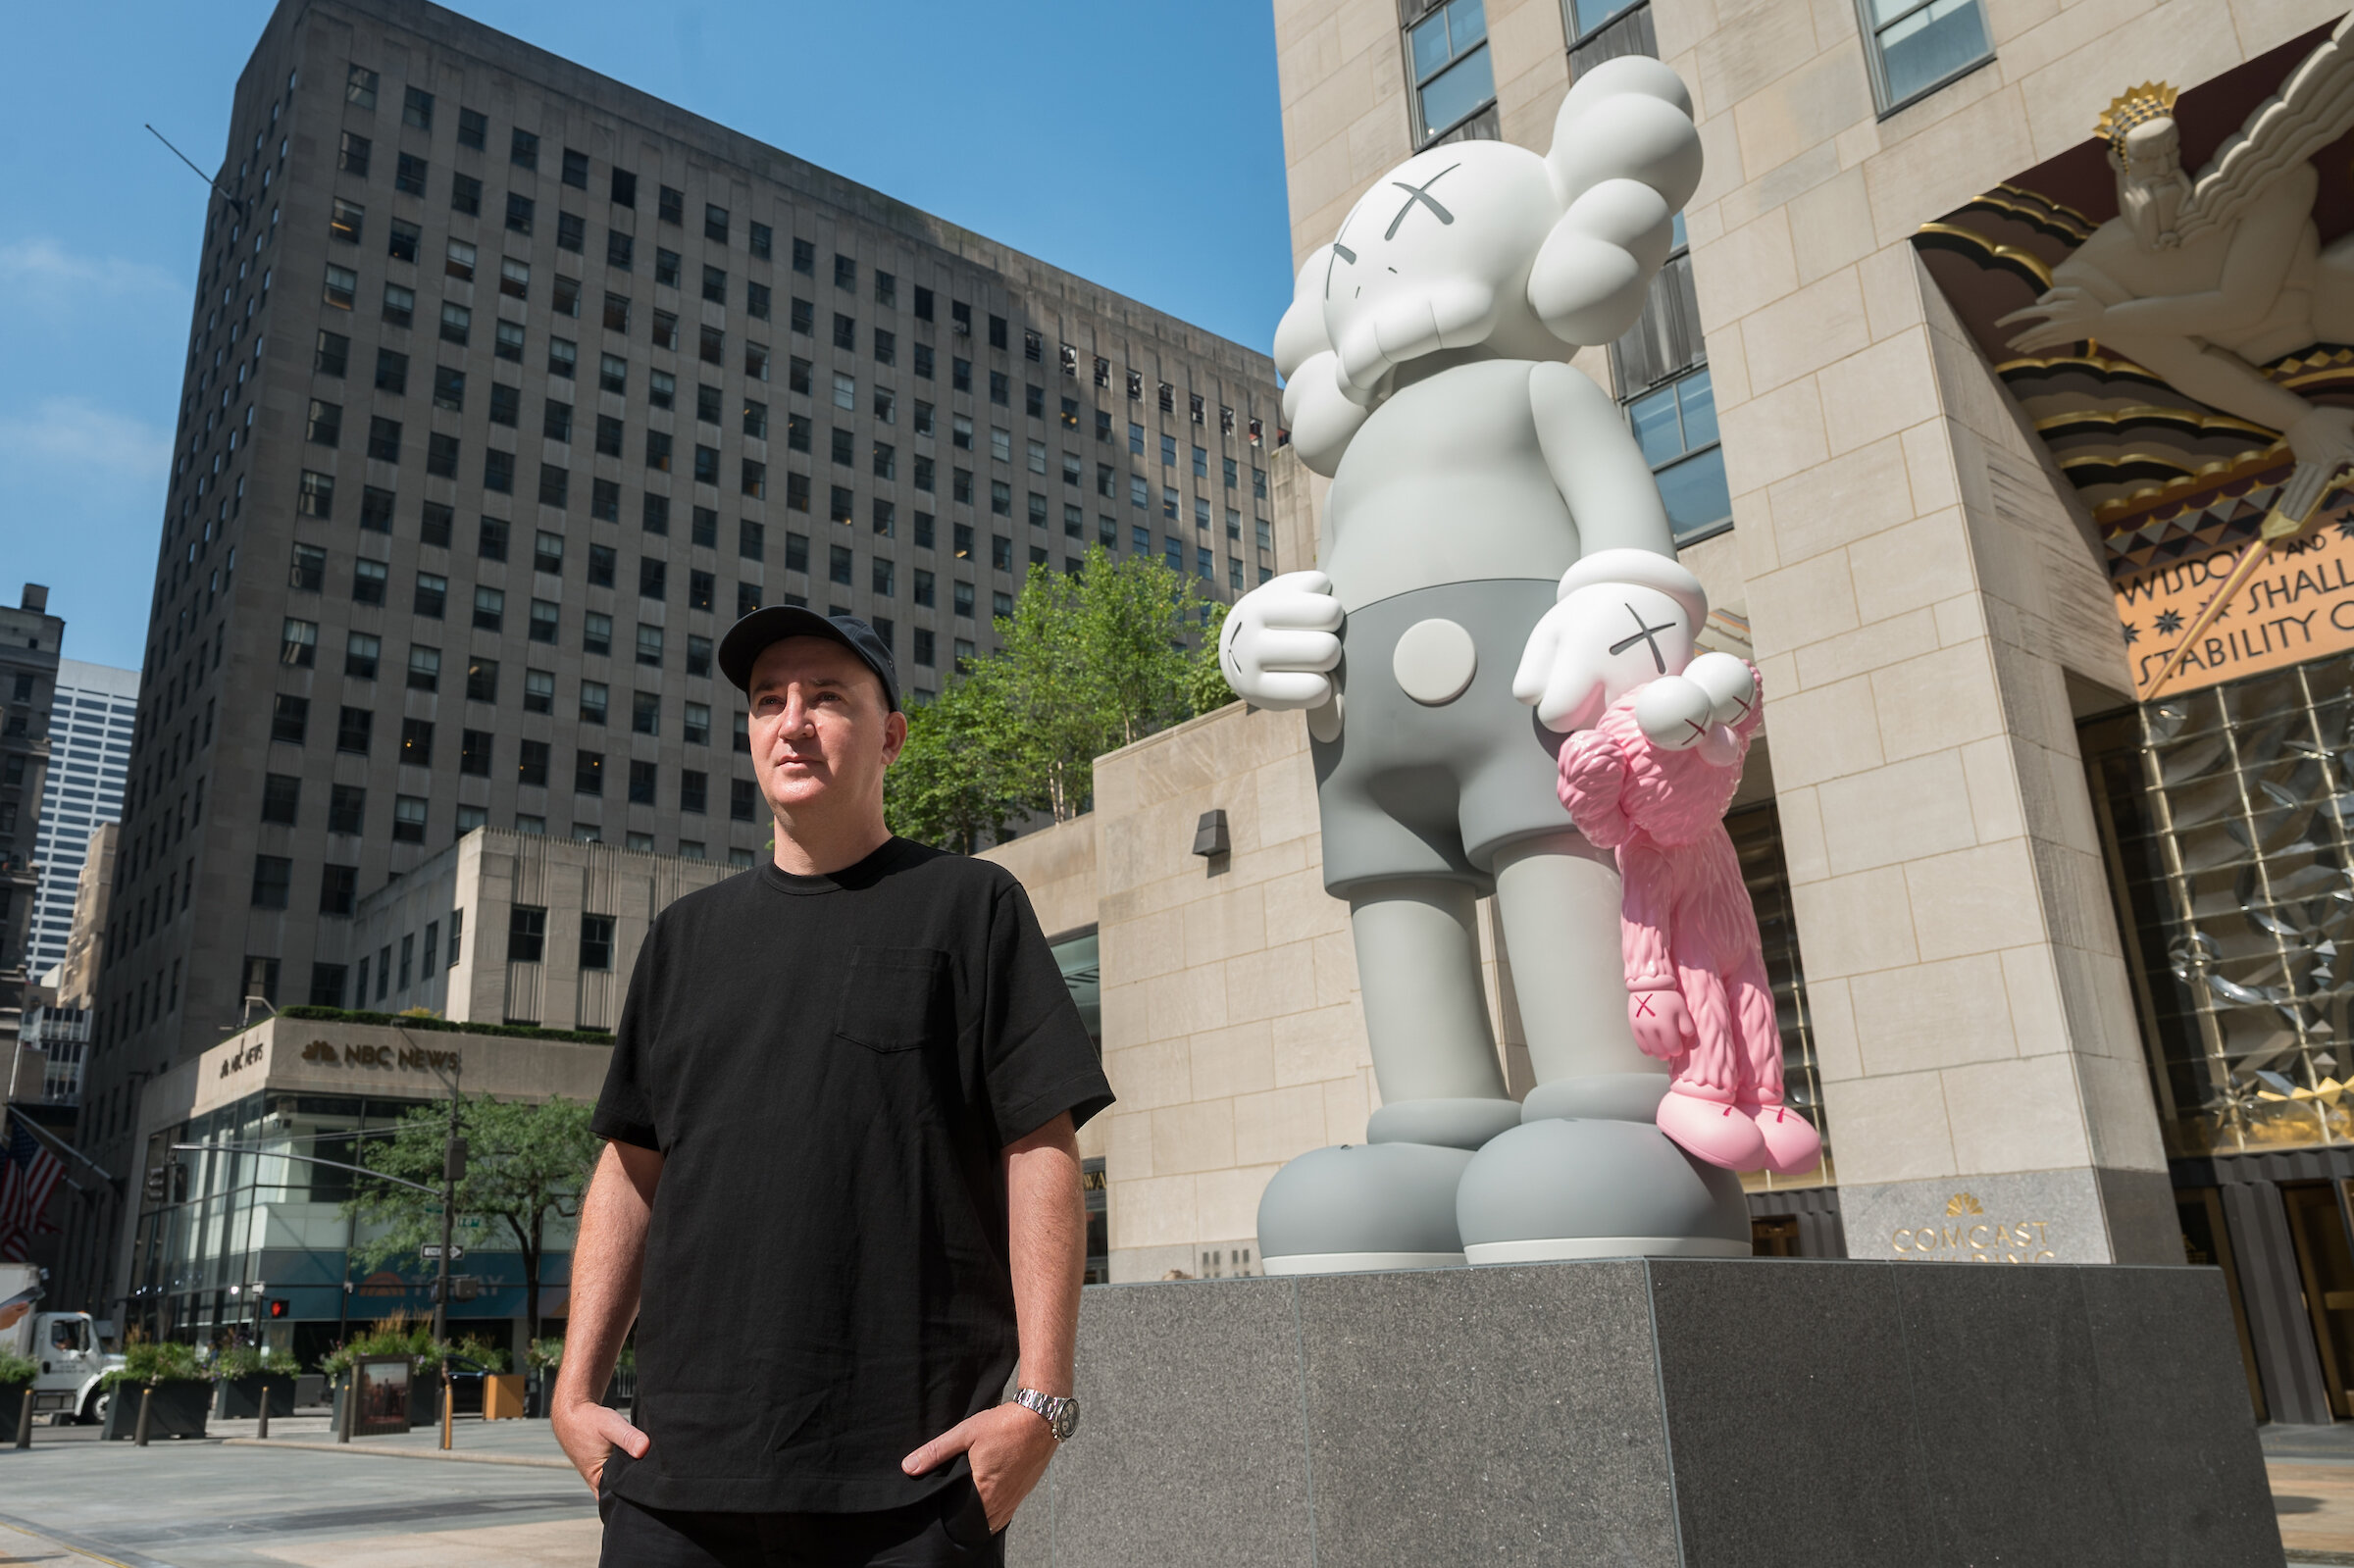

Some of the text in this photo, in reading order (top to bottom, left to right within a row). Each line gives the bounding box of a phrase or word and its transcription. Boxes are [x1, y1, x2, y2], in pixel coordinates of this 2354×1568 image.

[2285, 534, 2326, 561] AND
[2248, 559, 2354, 614] SHALL
[344, 1043, 458, 1071] NBC NEWS
[1892, 1221, 2049, 1253] COMCAST
